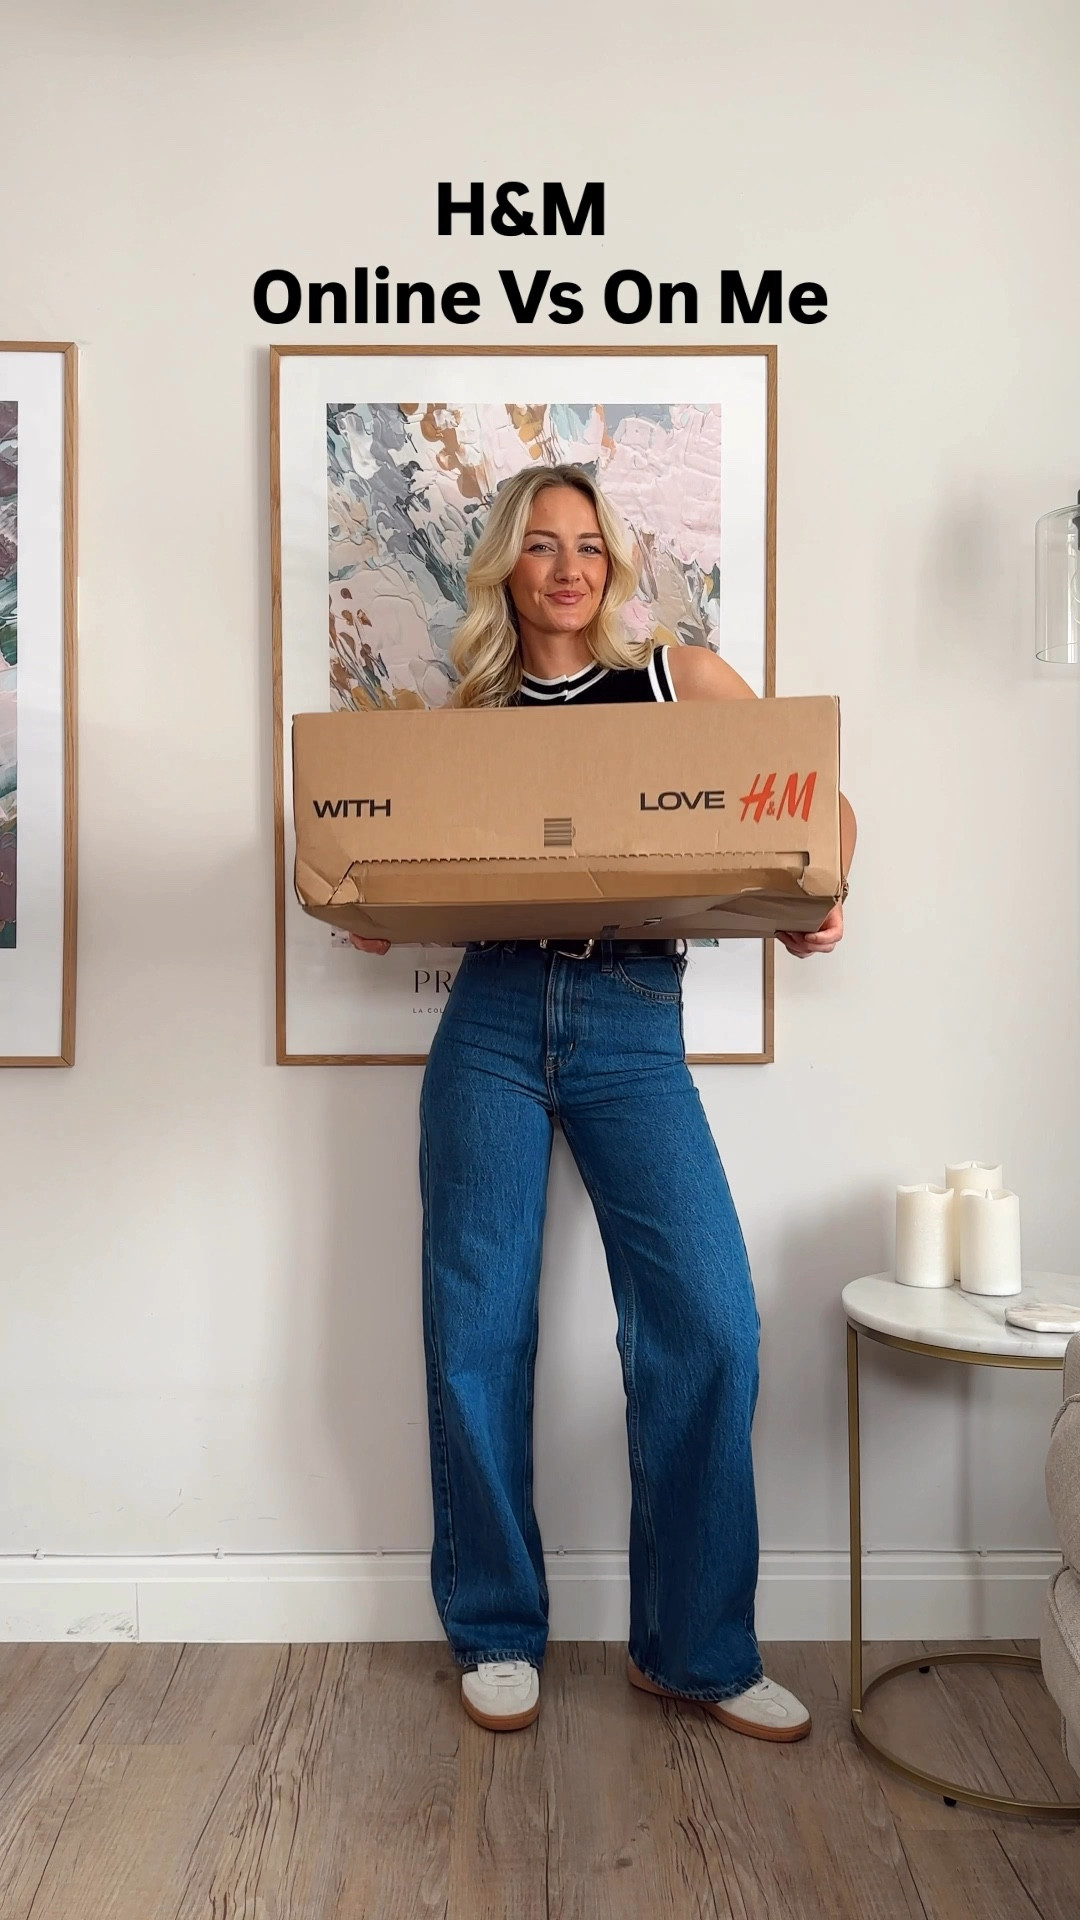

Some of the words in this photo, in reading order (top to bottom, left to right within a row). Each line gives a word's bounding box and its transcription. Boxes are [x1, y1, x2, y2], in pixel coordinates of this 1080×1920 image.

[313, 798, 391, 819] WITH
[640, 790, 725, 811] LOVE
[739, 770, 817, 823] H&M
